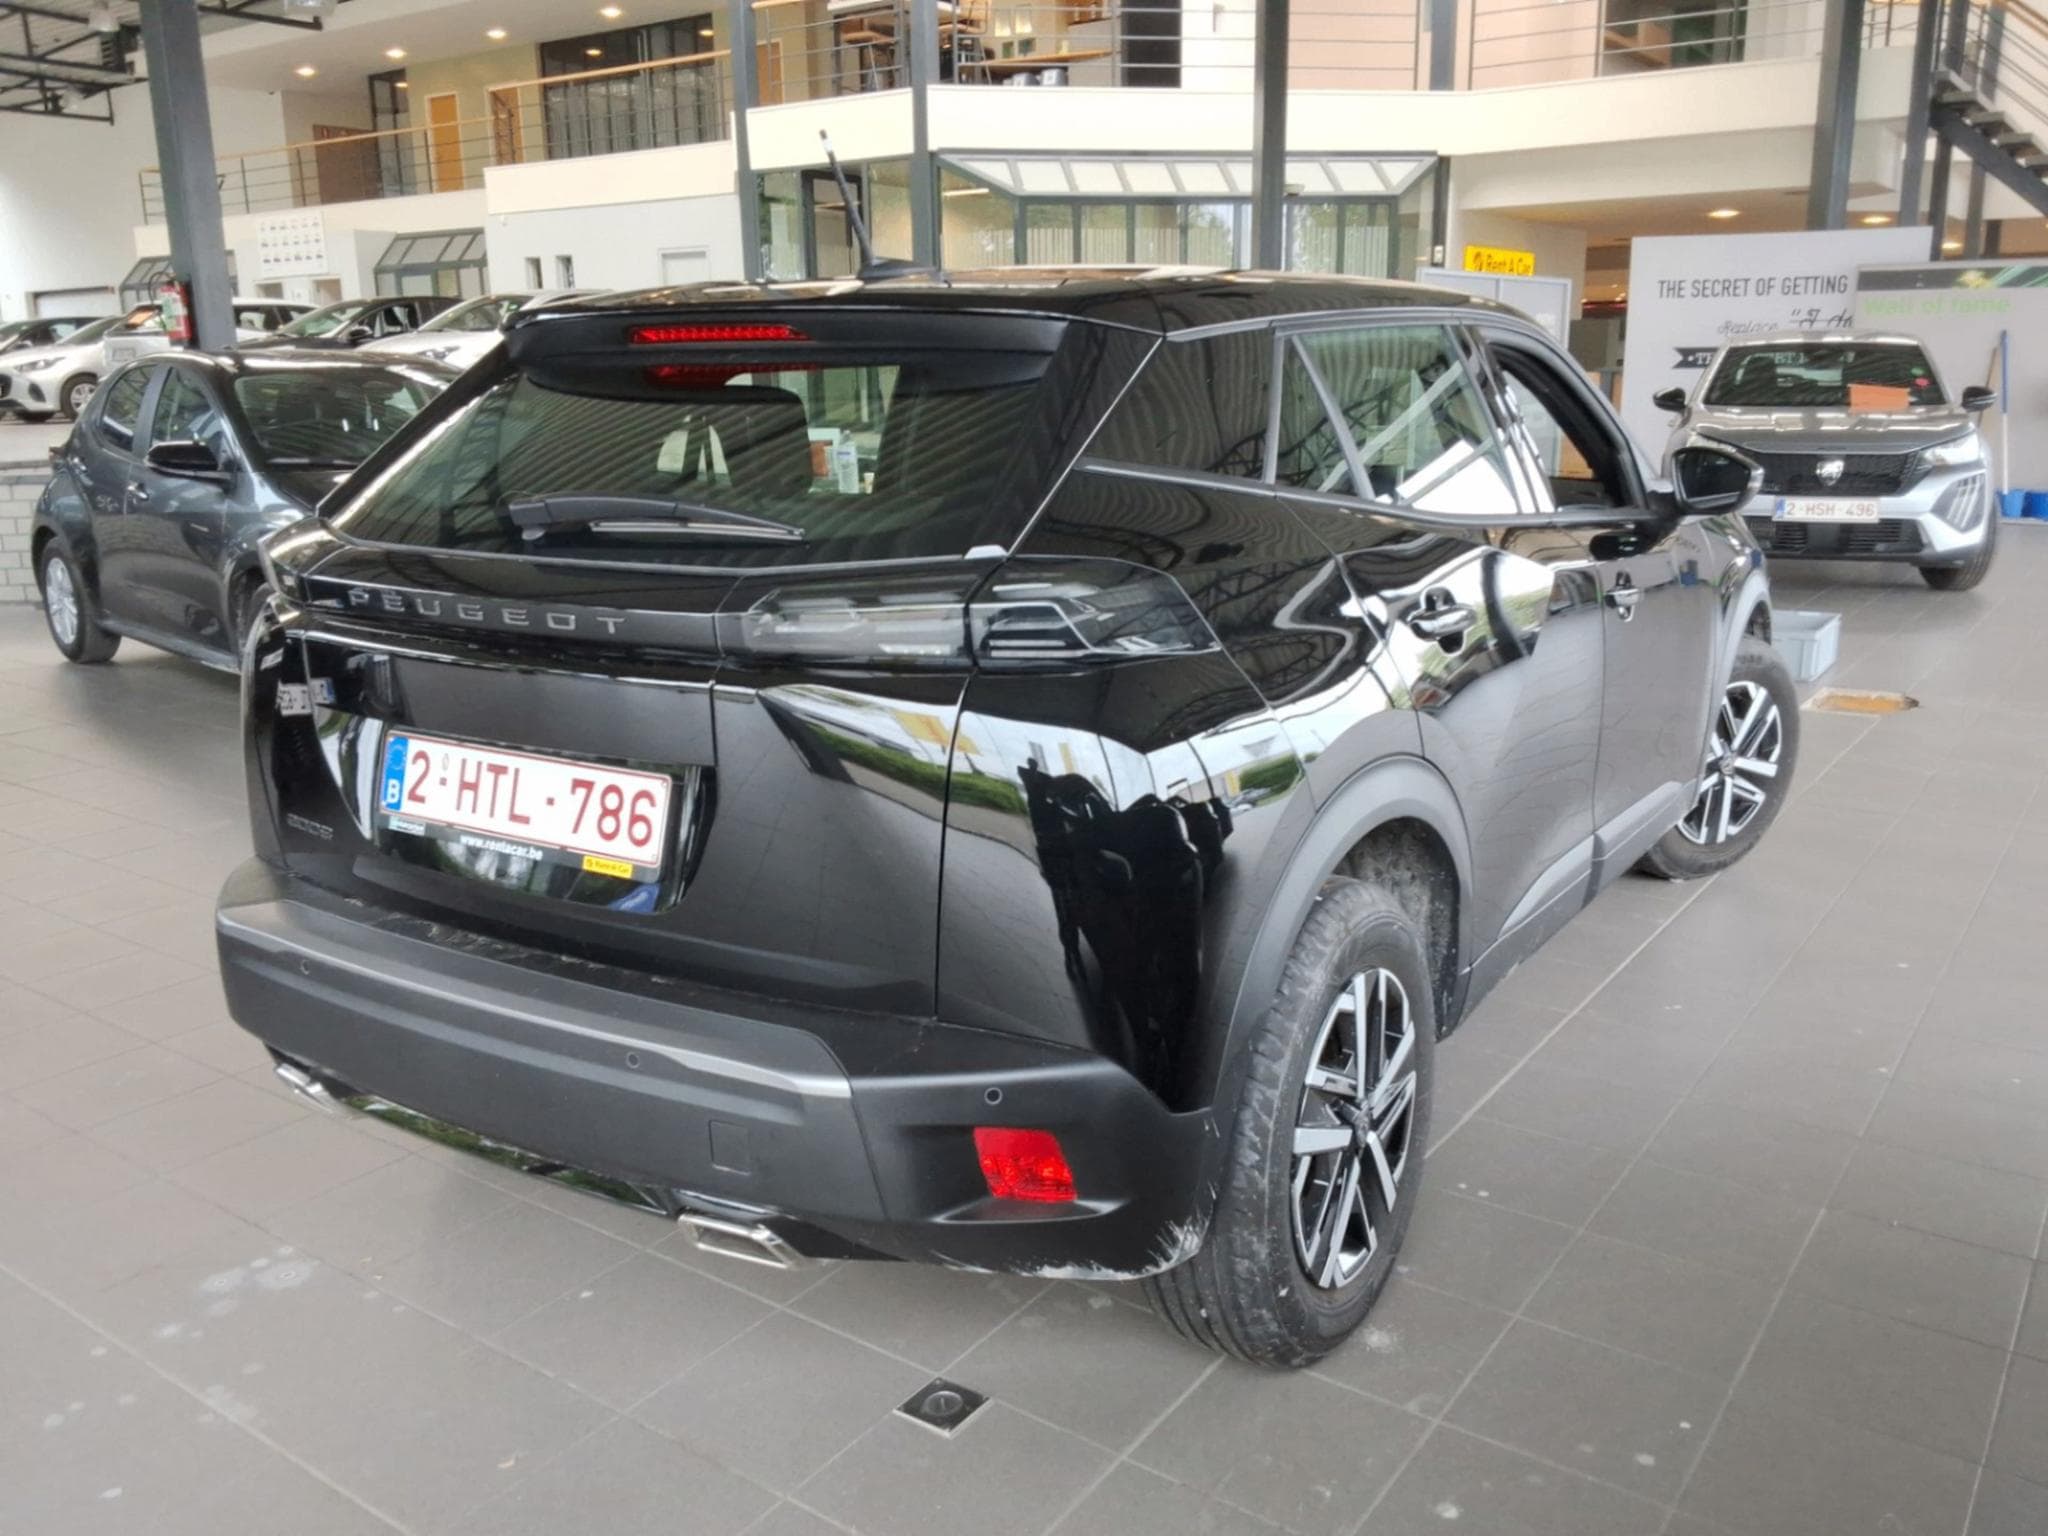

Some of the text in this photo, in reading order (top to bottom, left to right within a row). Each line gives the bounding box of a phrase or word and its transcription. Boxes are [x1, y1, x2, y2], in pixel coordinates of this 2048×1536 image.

[1658, 274, 1849, 299] THE SECRET OF GETTING
[348, 586, 626, 635] PEUGEOT
[386, 778, 400, 804] B
